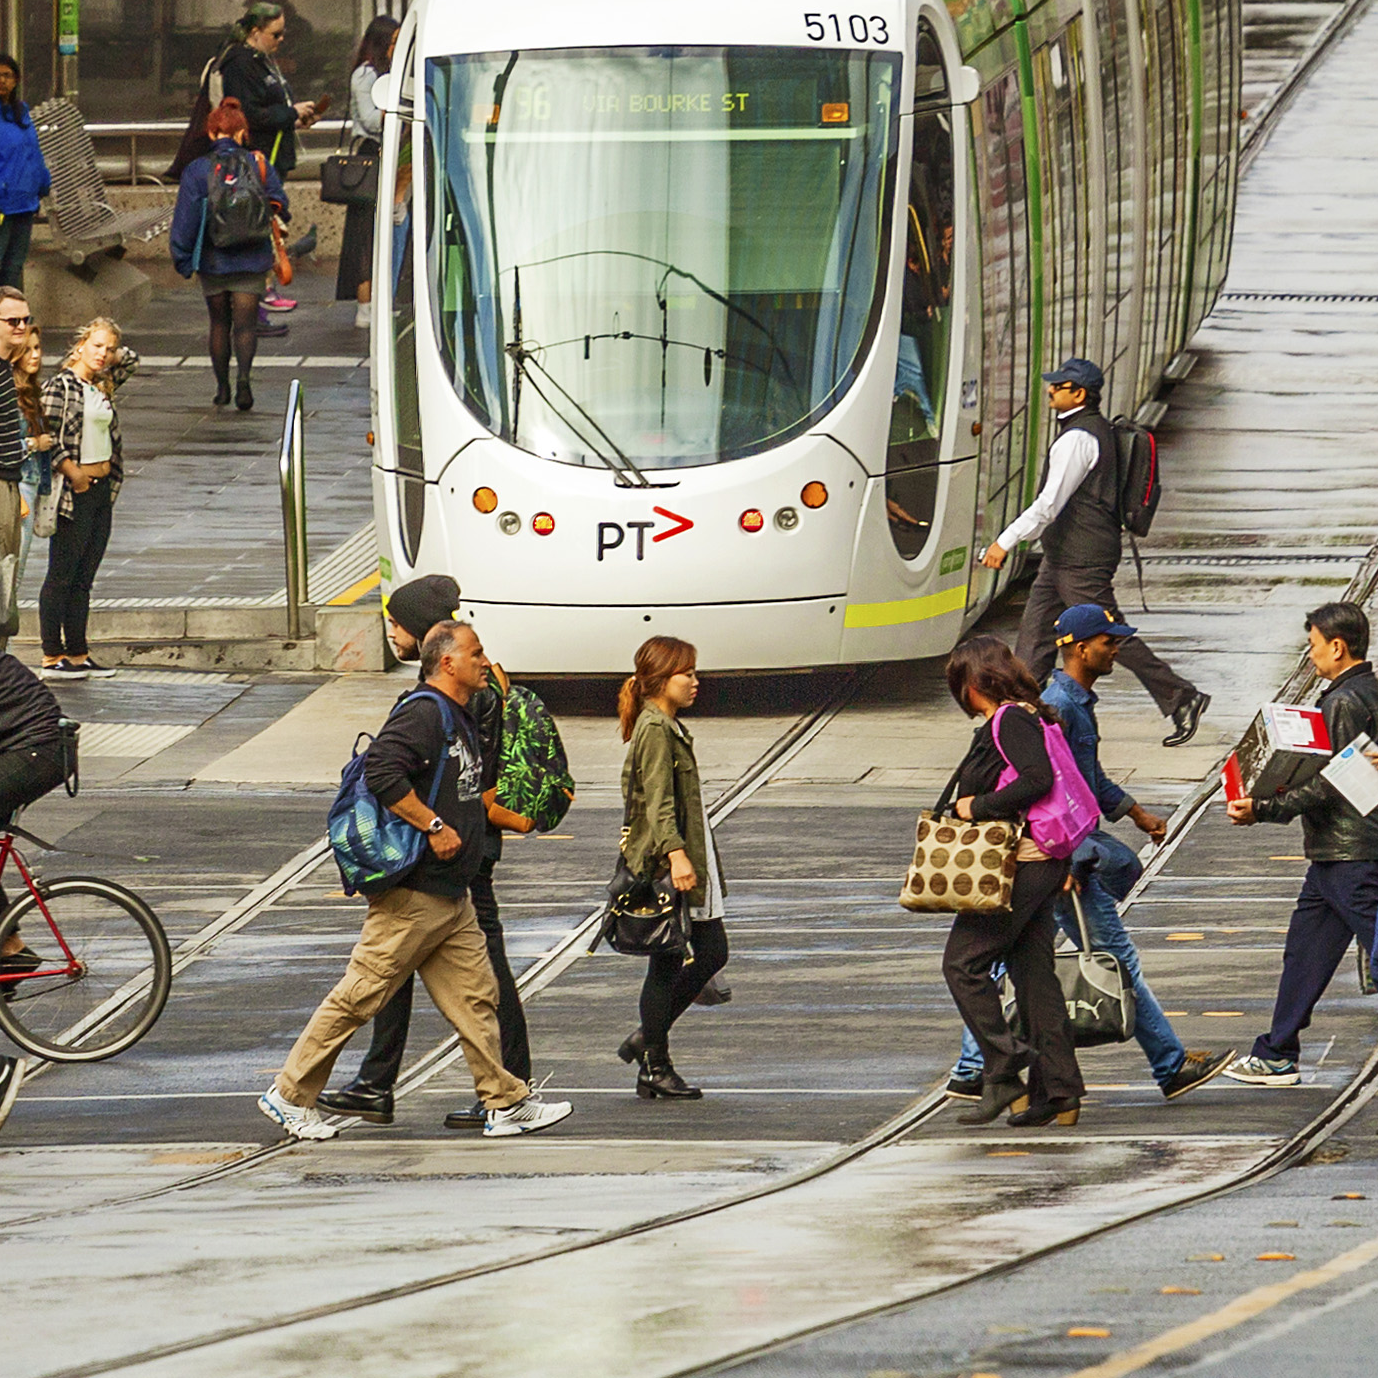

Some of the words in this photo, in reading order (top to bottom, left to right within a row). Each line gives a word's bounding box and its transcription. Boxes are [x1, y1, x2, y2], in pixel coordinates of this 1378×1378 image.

[804, 13, 890, 45] 5103
[515, 86, 552, 120] 96
[582, 96, 620, 113] VIA
[629, 94, 711, 114] BOURKE
[721, 92, 750, 112] ST
